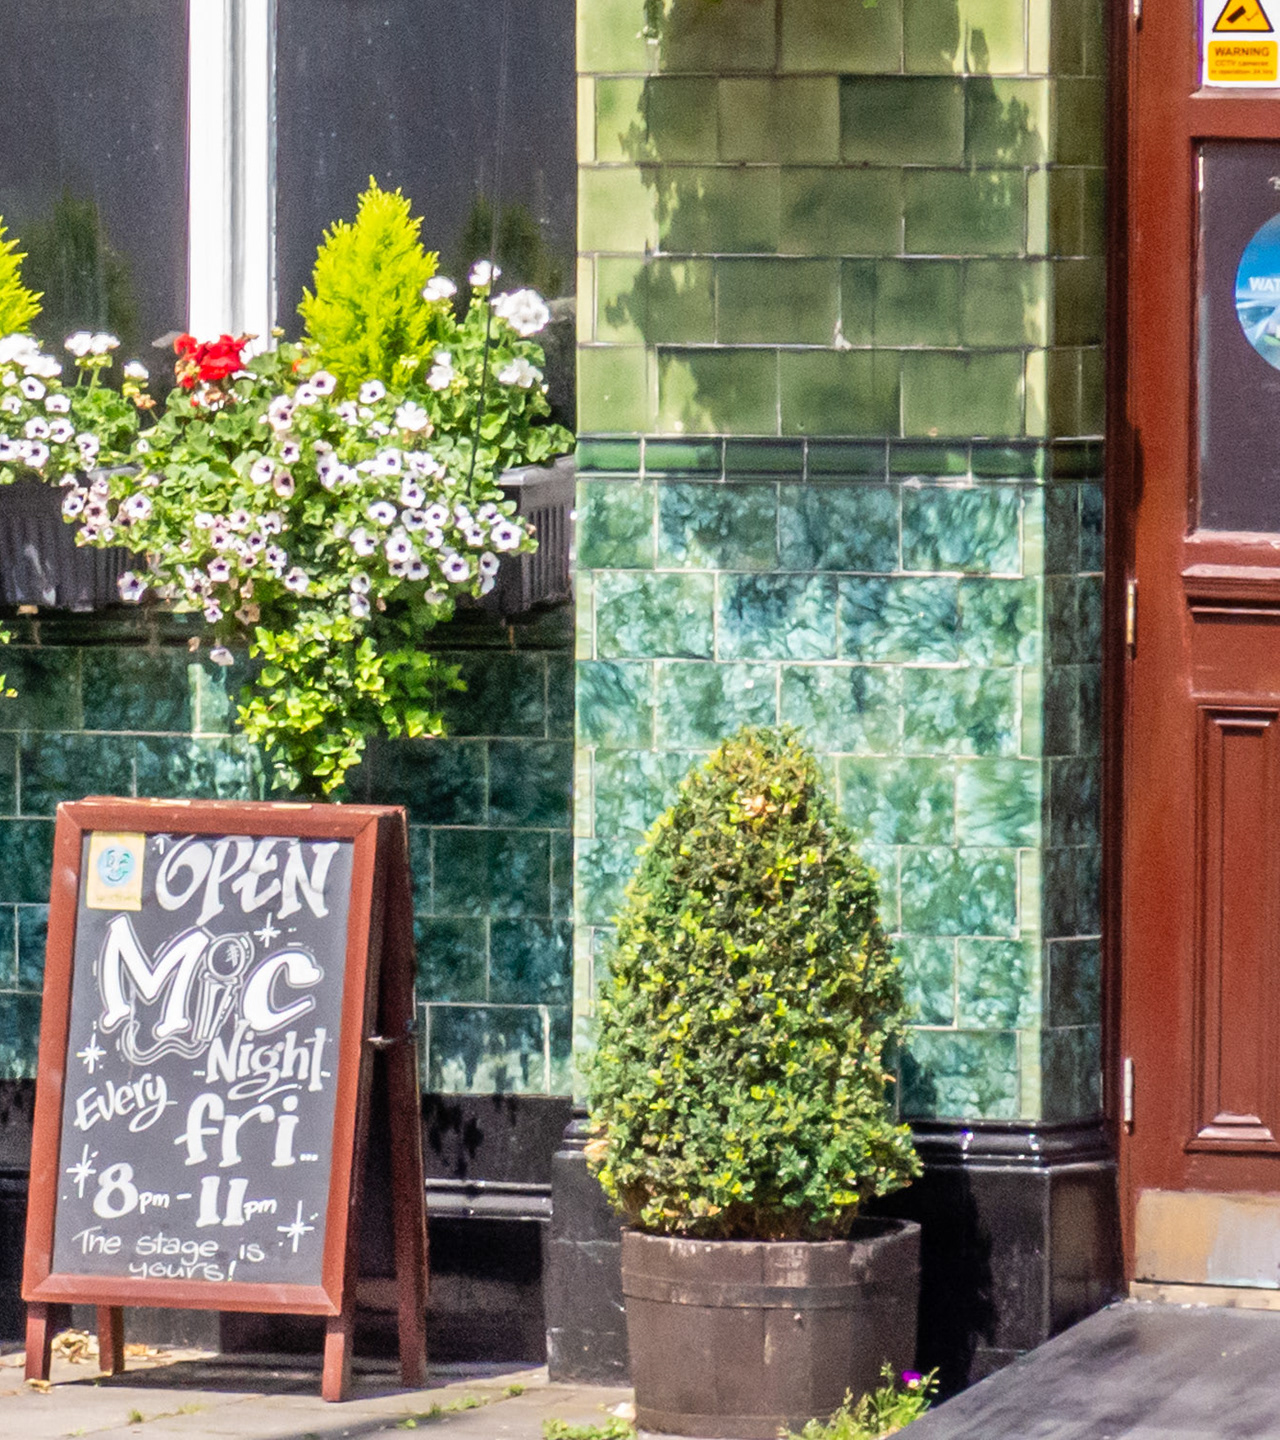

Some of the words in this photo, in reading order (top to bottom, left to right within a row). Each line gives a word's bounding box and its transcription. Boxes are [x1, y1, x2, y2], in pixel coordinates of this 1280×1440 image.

[1214, 46, 1270, 57] WARNING
[155, 835, 339, 927] OPEN
[73, 1073, 179, 1133] Every
[71, 1225, 122, 1255] The
[135, 1231, 220, 1266] stage
[238, 1237, 266, 1263] is
[128, 1260, 237, 1282] yours!
